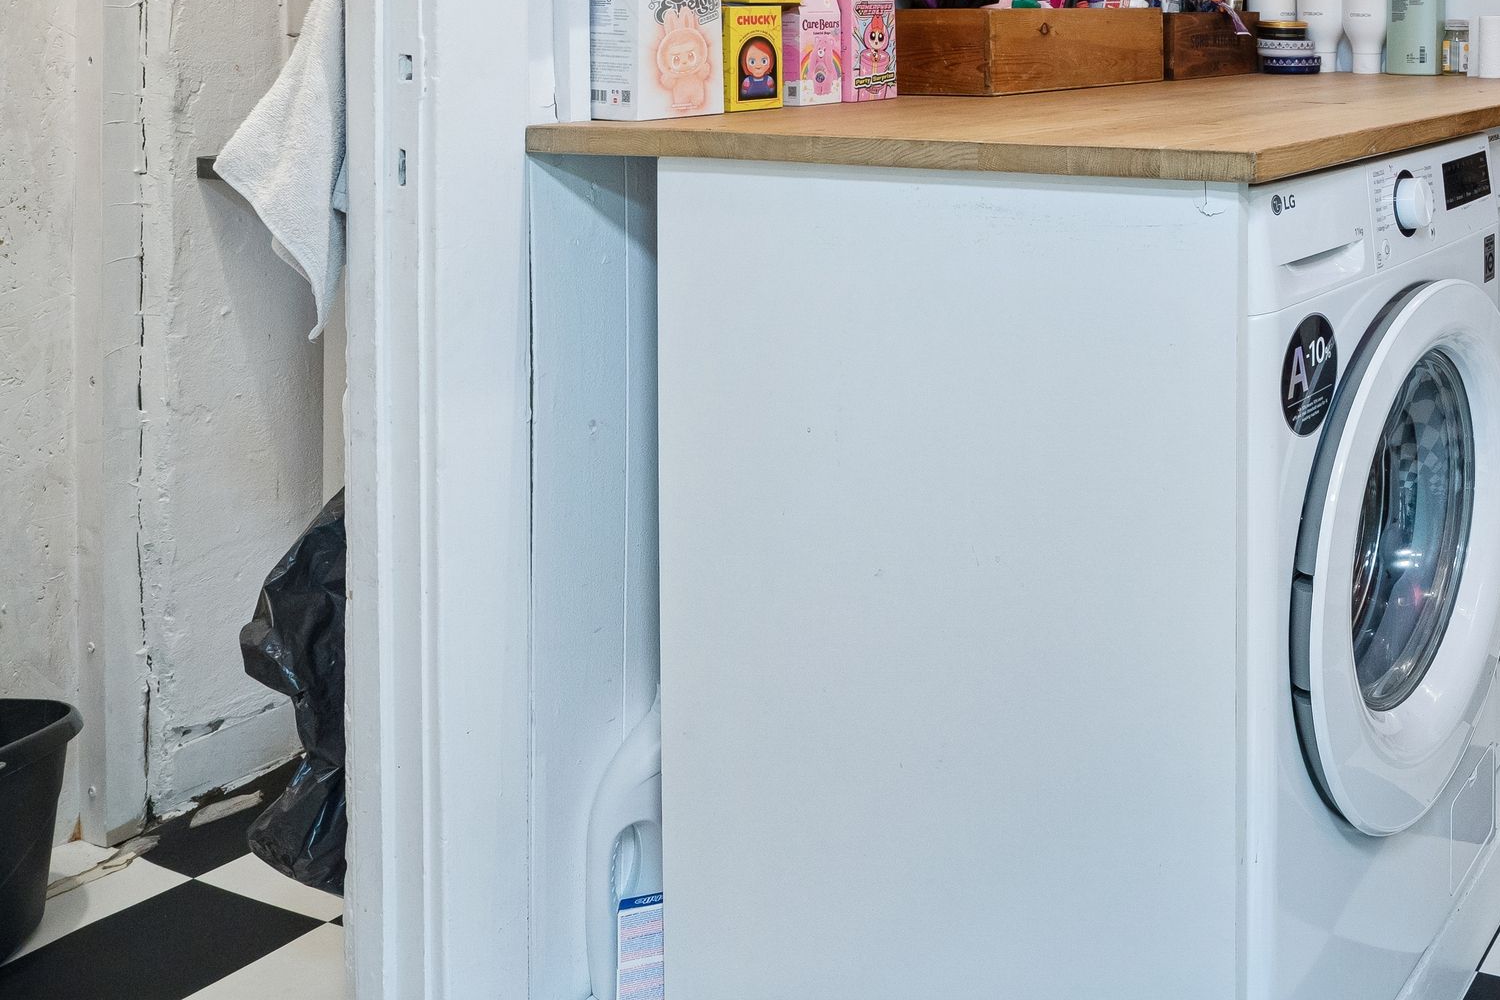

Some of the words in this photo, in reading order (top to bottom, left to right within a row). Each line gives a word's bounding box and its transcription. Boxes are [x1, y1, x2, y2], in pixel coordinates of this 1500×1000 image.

[736, 14, 777, 26] CHUCKY
[802, 19, 819, 31] Care
[819, 18, 839, 30] Bears
[1283, 194, 1296, 210] LG
[1287, 346, 1309, 400] A
